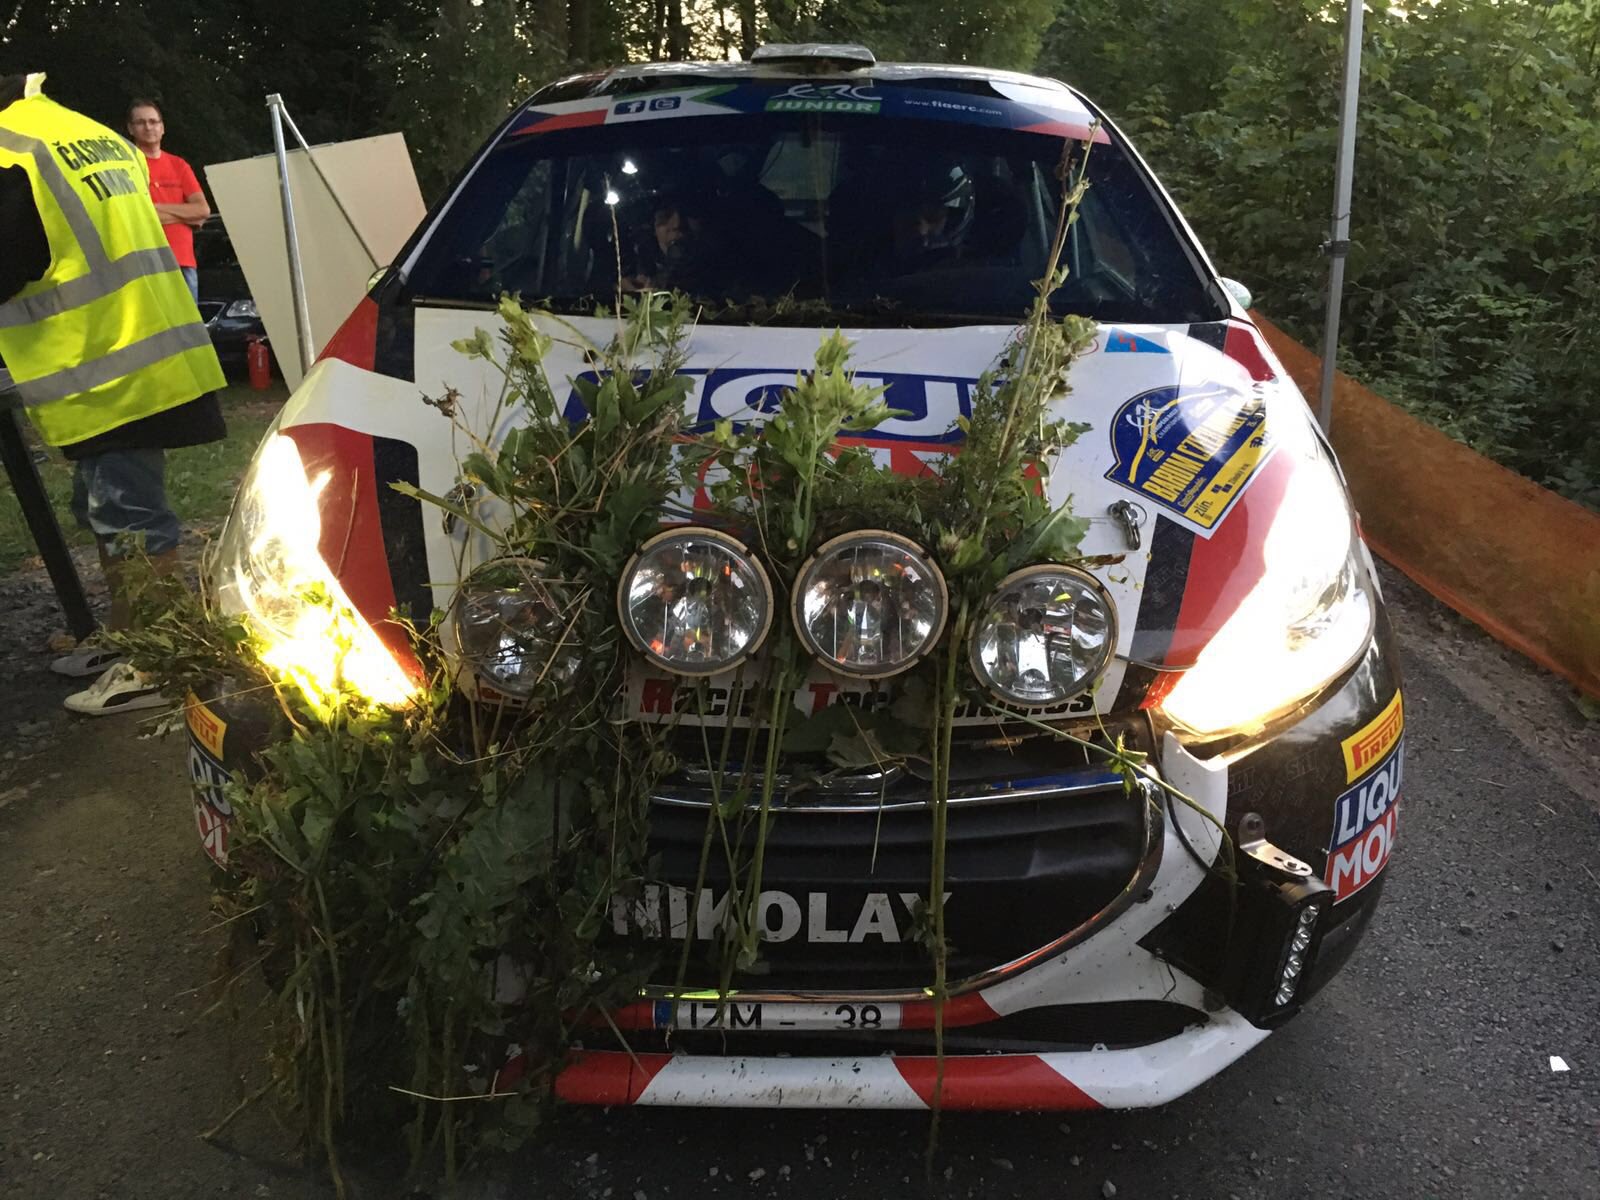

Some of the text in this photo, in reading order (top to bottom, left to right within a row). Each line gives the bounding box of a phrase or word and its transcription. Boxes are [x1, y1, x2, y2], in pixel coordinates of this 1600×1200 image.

[772, 102, 873, 111] JUNIOR
[1142, 452, 1205, 503] BARUM
[1337, 757, 1401, 846] LIQU
[1331, 803, 1400, 897] MOL
